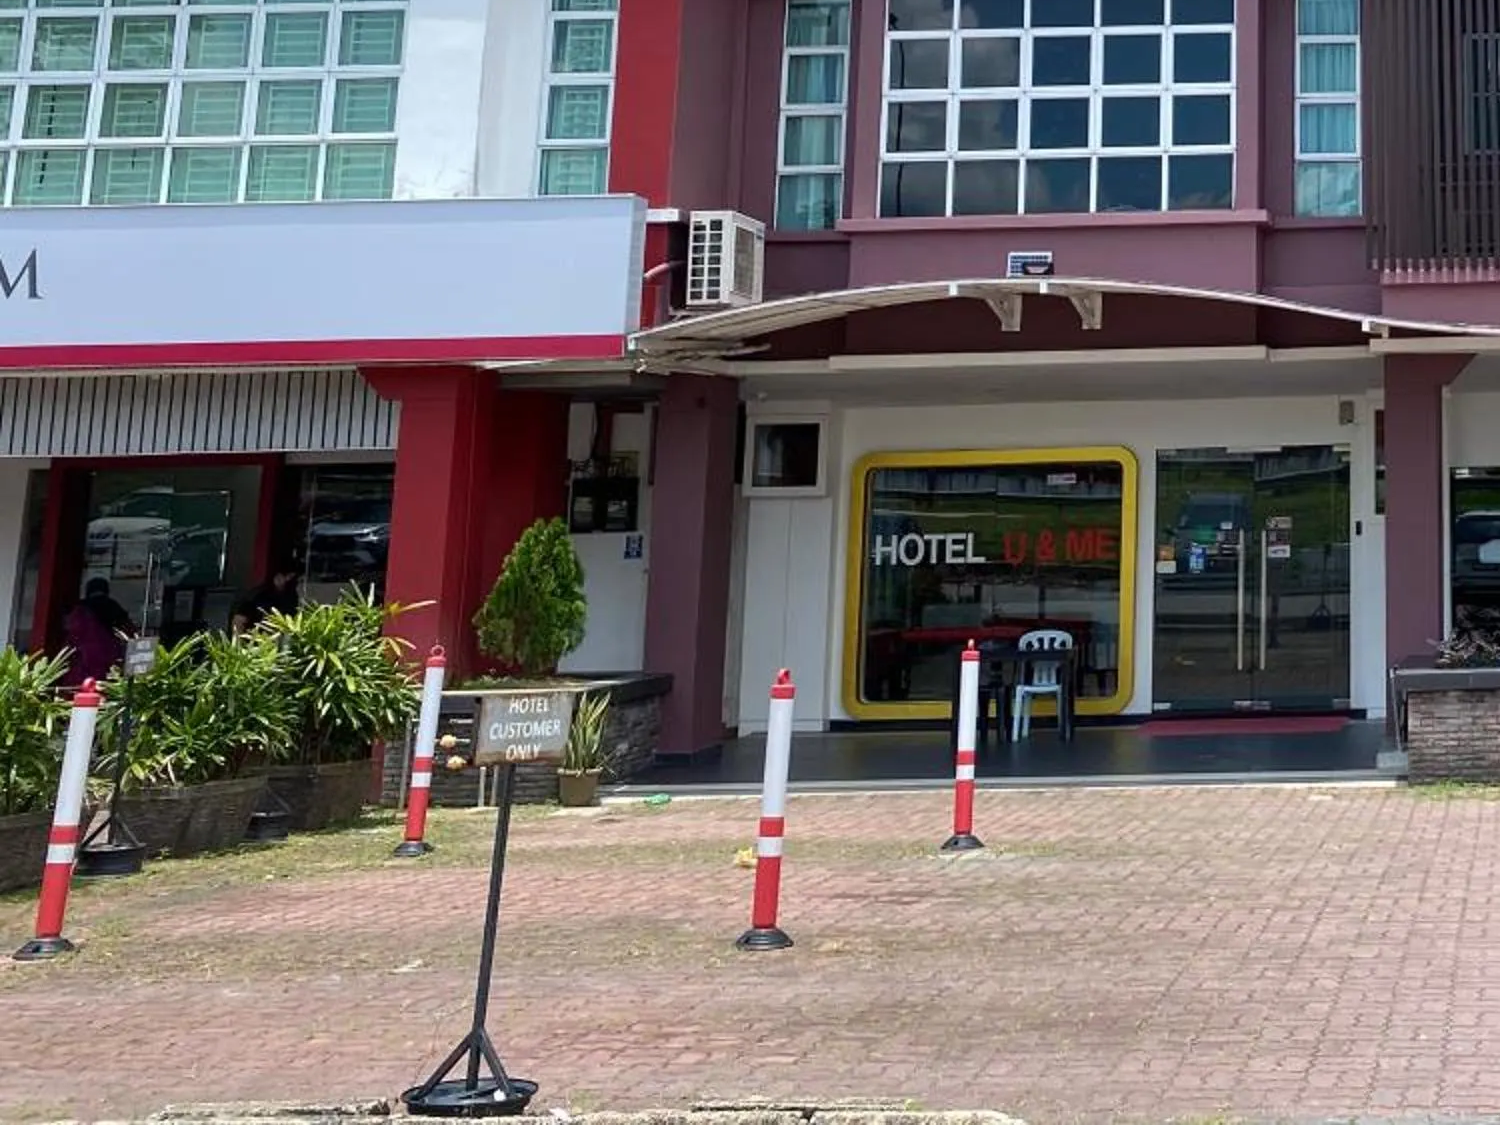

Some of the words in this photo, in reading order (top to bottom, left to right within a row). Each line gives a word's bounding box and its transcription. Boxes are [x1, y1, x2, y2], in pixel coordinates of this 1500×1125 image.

[874, 532, 987, 566] HOTEL
[1003, 531, 1028, 566] U
[1036, 528, 1056, 561] &
[1065, 528, 1119, 560] ME
[508, 696, 550, 714] HOTEL
[489, 718, 561, 740] CUSTOMER
[505, 742, 541, 761] ONLY
